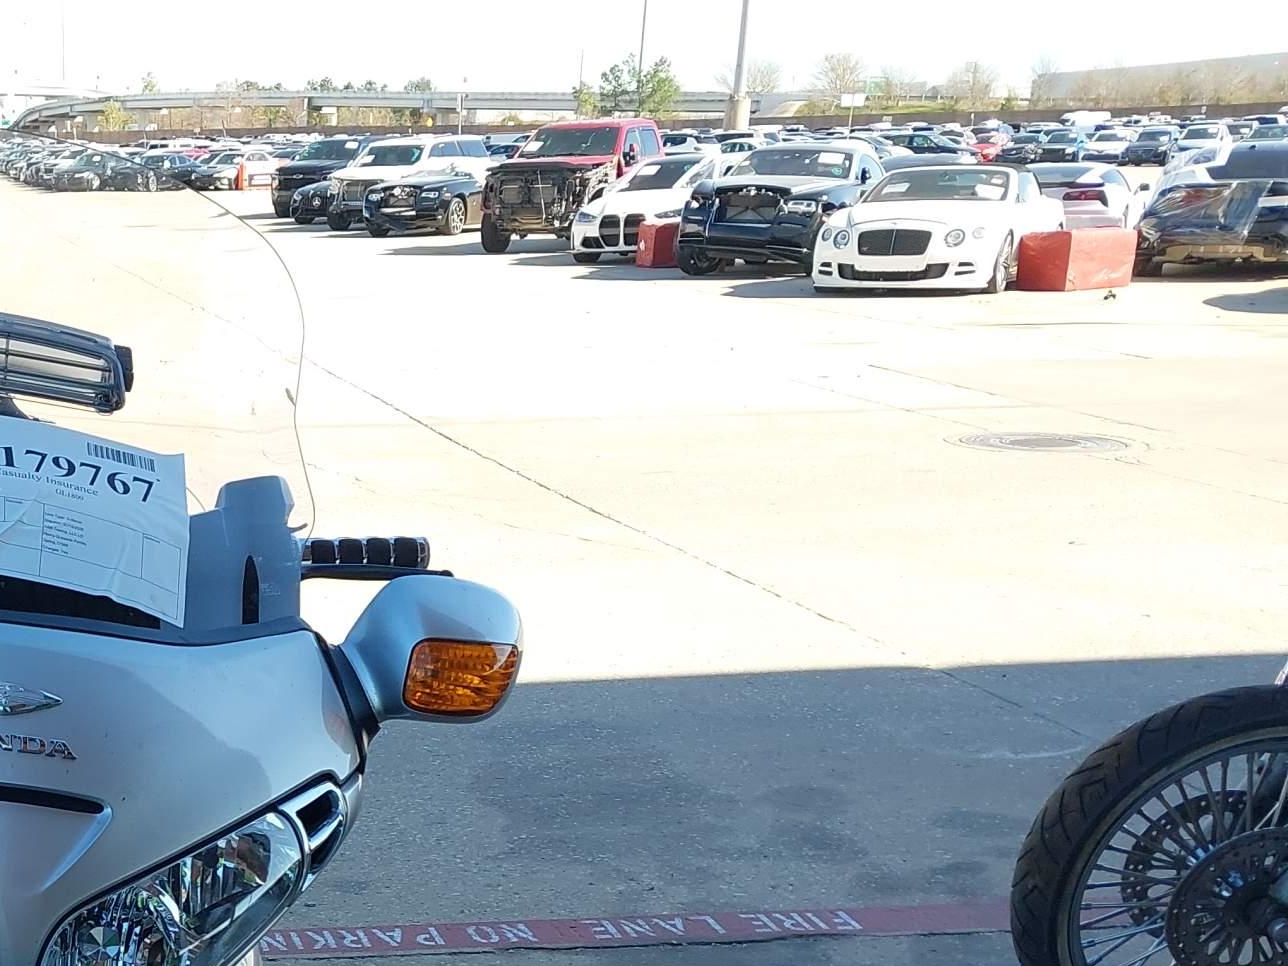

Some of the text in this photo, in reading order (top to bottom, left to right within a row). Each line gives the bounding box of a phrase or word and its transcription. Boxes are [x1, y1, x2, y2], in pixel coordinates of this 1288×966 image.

[46, 476, 99, 496] Insurance
[580, 915, 727, 940] LANE
[737, 909, 863, 932] FIRE
[465, 922, 539, 944] NO
